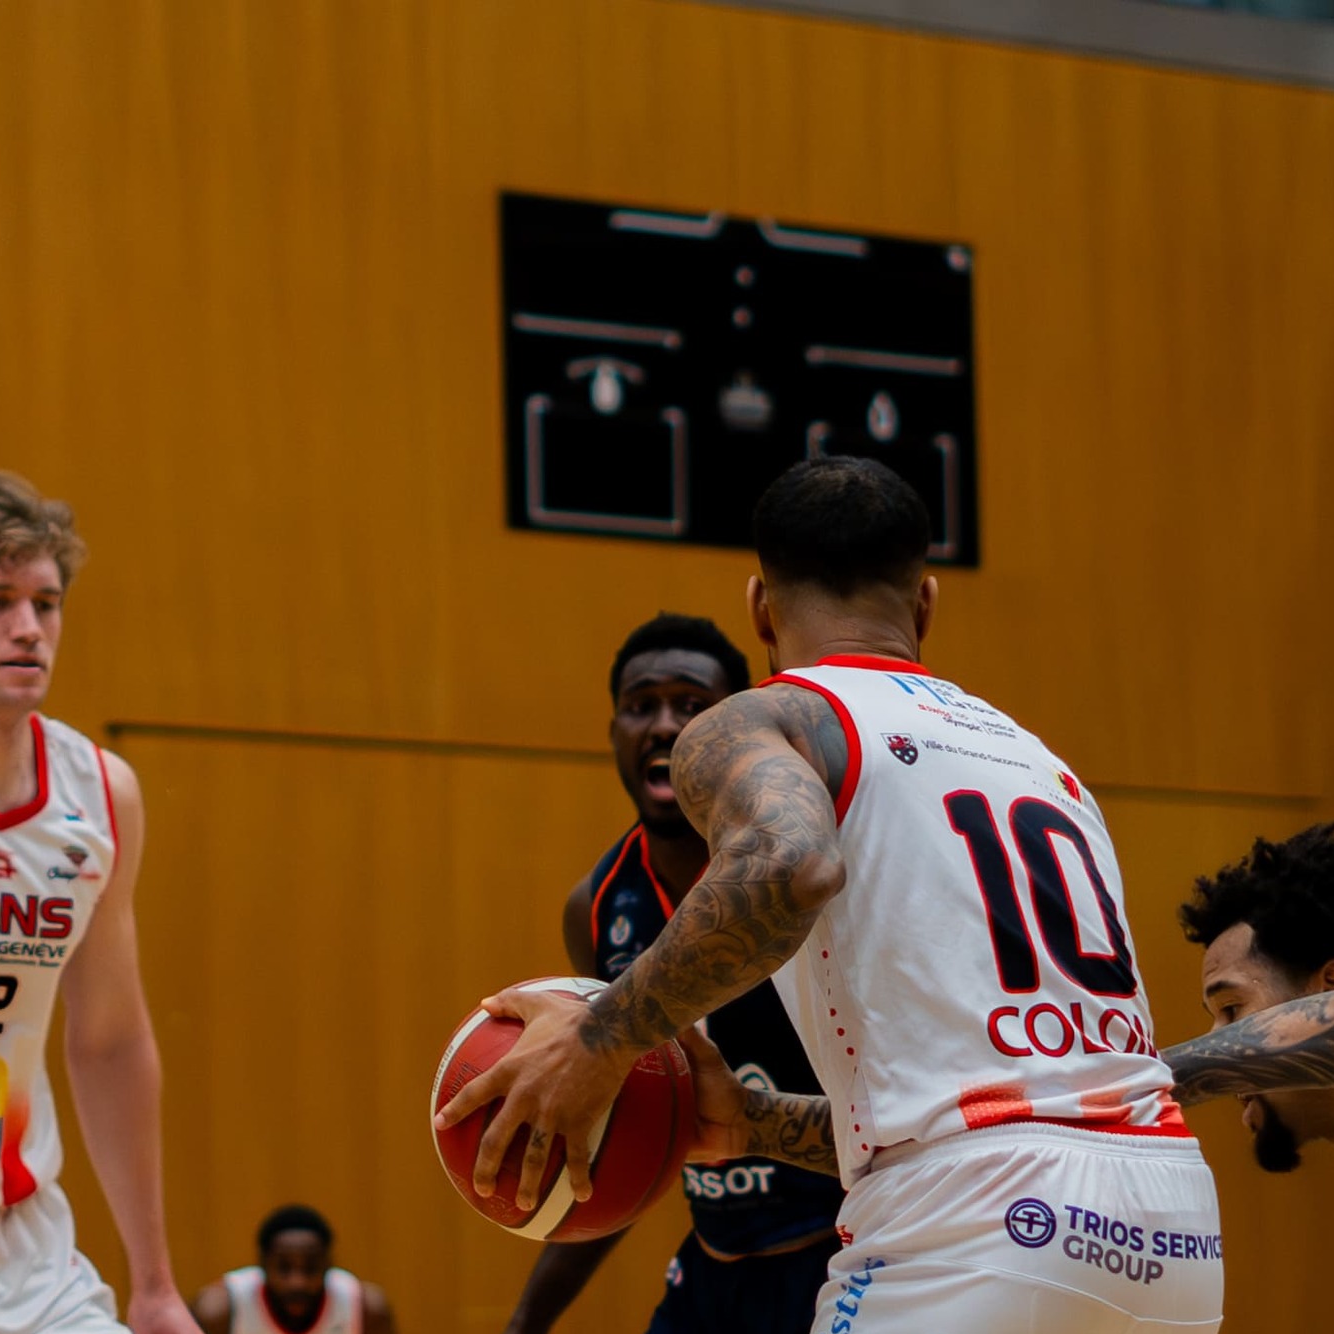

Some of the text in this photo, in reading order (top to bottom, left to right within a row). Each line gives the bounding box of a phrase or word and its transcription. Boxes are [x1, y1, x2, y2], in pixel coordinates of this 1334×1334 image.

[943, 789, 1139, 998] 10
[1064, 1204, 1145, 1252] TRIOS
[1063, 1235, 1164, 1285] GROUP
